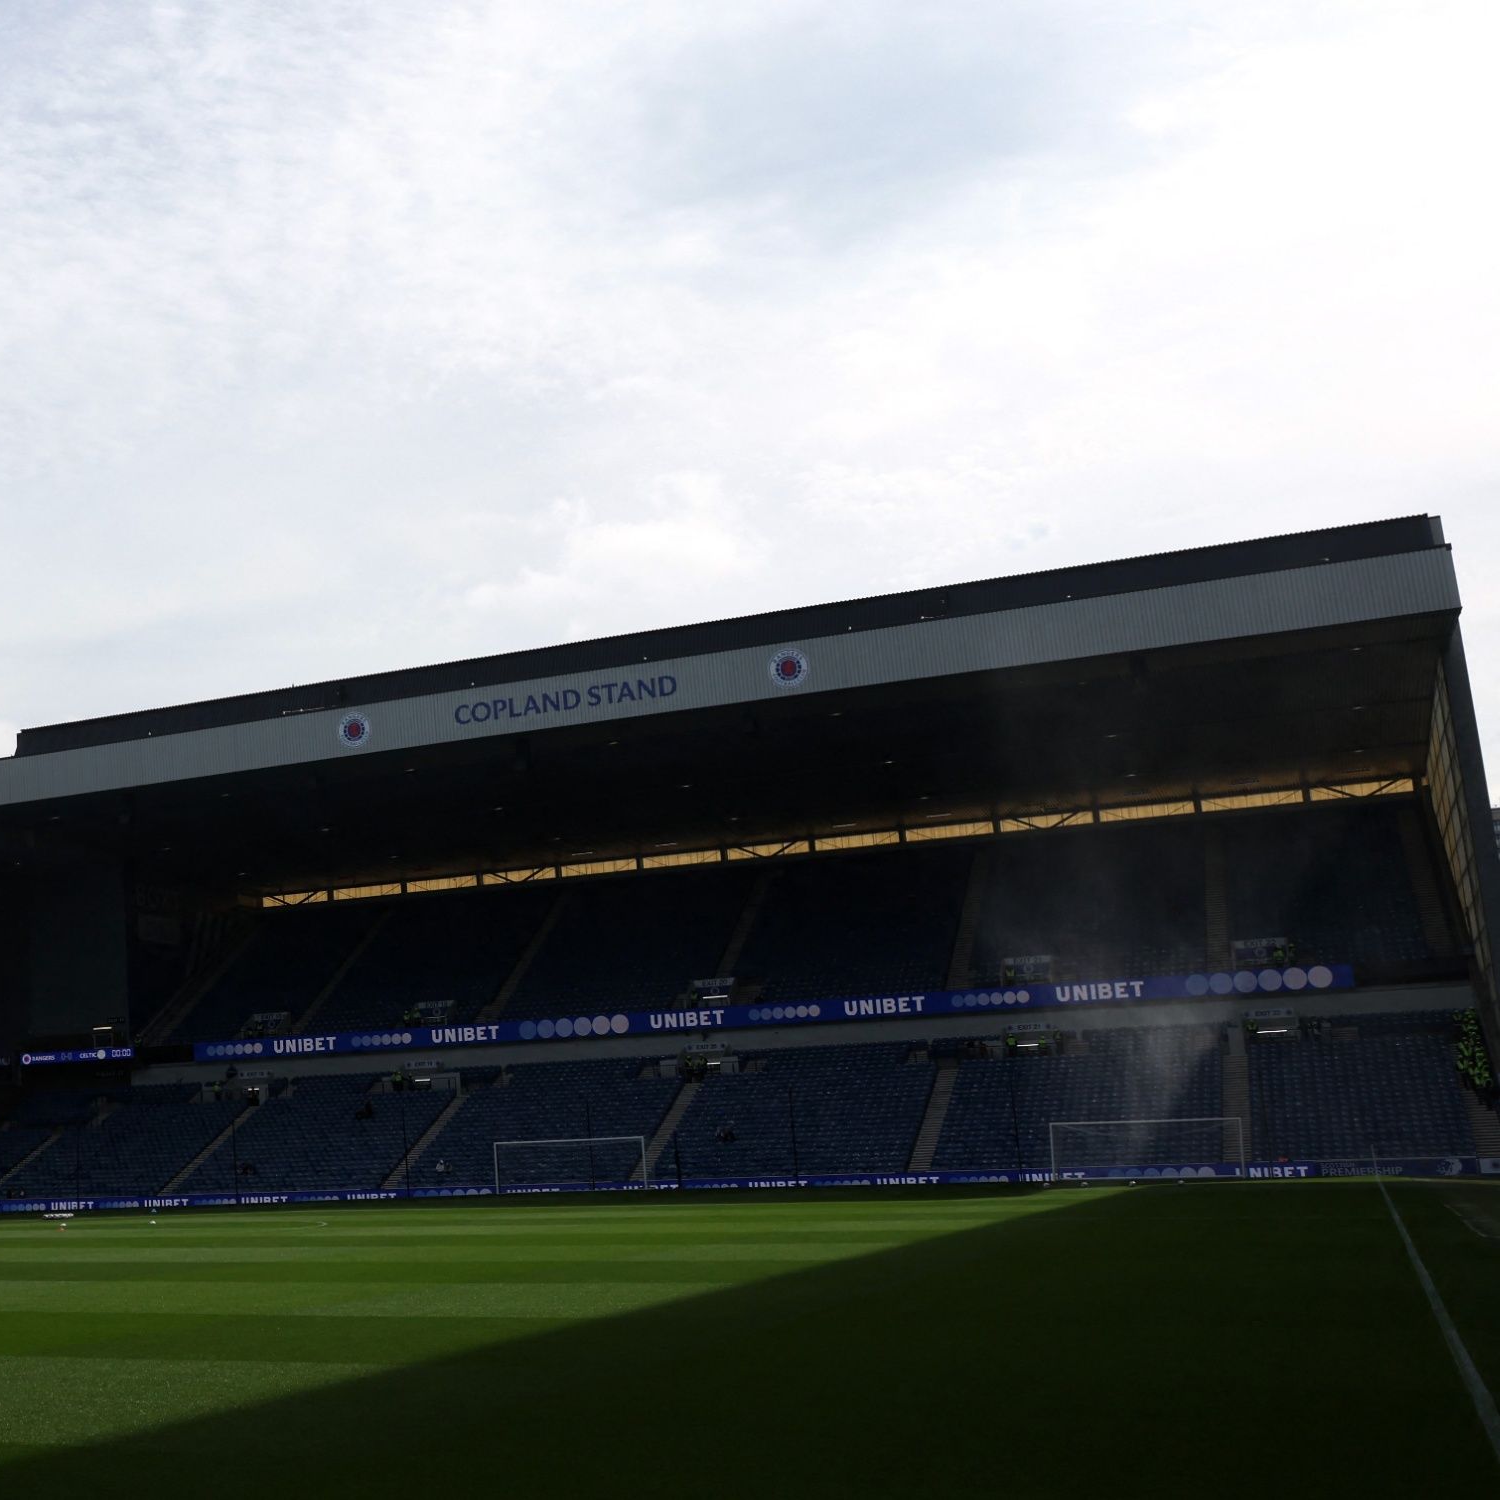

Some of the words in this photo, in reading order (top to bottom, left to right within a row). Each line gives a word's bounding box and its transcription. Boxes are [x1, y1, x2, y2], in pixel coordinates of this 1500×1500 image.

[455, 689, 581, 725] COPLAND
[587, 675, 677, 706] STAND
[1055, 981, 1144, 1002] UNIBET
[844, 995, 925, 1016] UNIBET
[650, 1009, 724, 1029] UNIBET
[431, 1025, 500, 1044] UNIBET
[111, 1048, 132, 1058] 00:00
[273, 1036, 337, 1054] UNIBET
[1321, 1166, 1403, 1177] PREMIERSHIP
[51, 1201, 94, 1211] UNIBET
